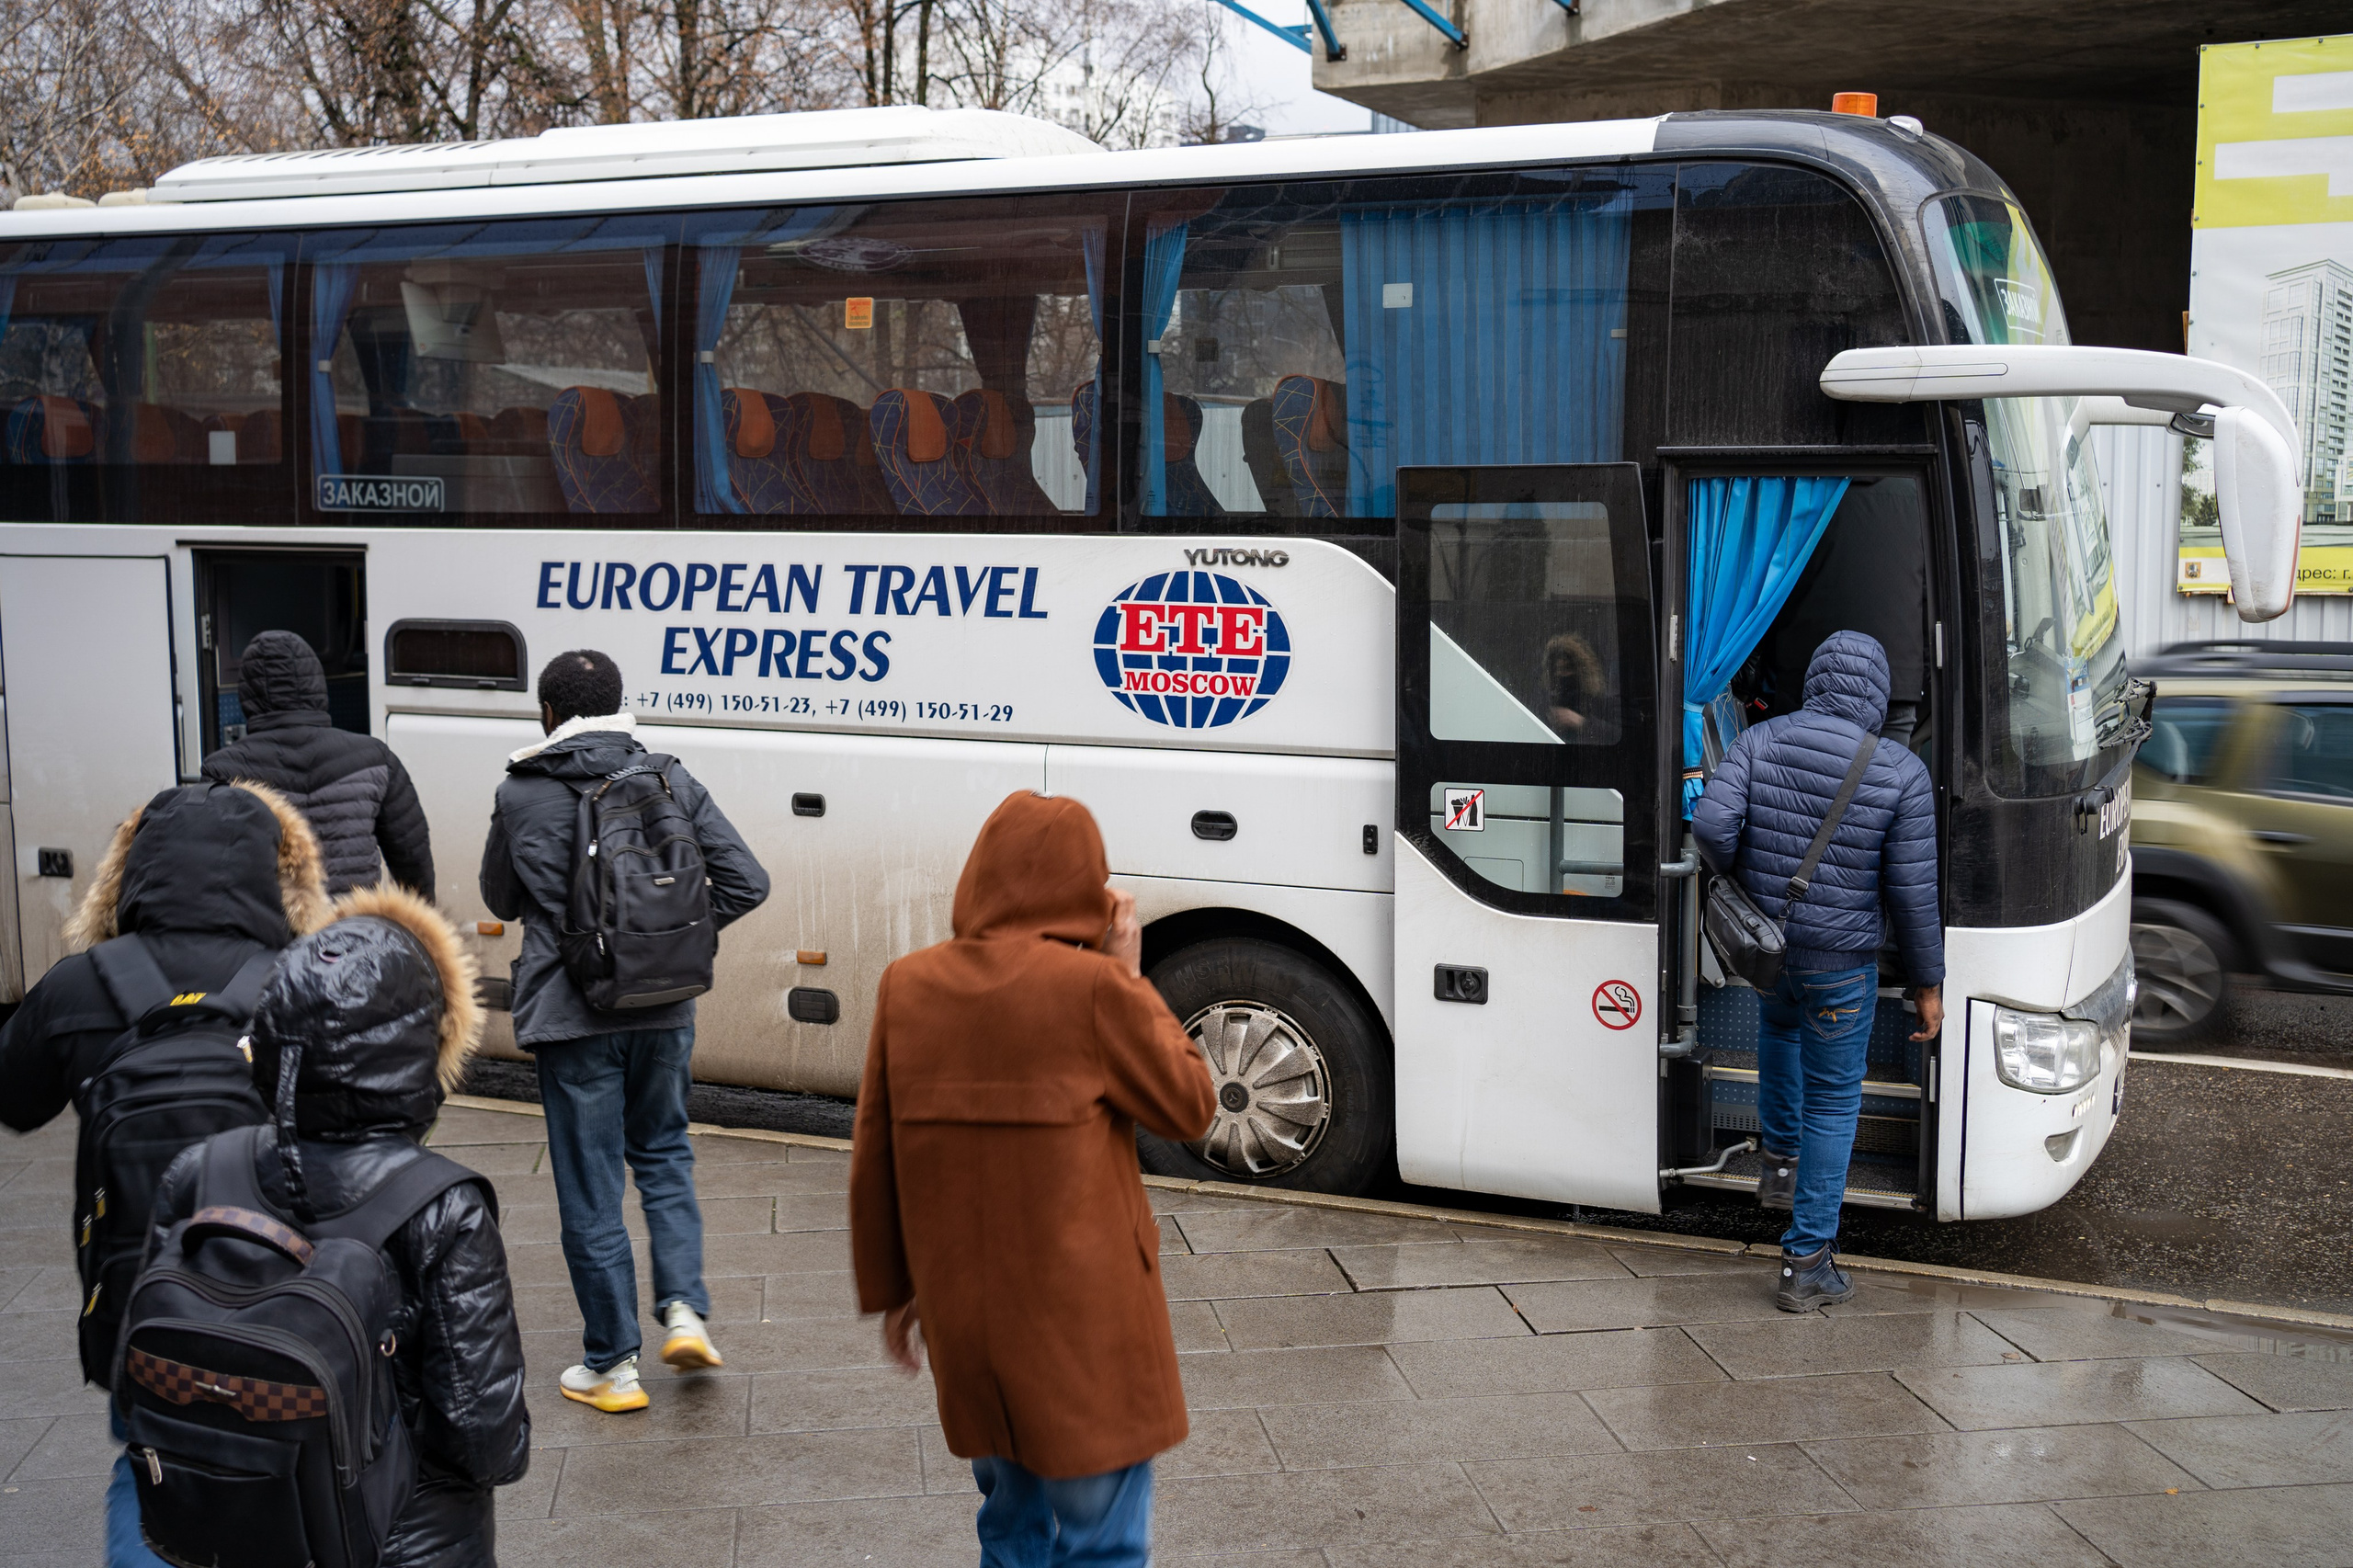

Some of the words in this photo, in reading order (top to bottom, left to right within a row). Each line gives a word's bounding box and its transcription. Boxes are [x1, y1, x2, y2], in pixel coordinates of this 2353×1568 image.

[323, 481, 439, 507] ЗАКАЗНОЙ
[1184, 549, 1290, 567] YUTONG
[2297, 569, 2336, 582] рес:
[537, 562, 823, 614] EUROPEAN
[844, 564, 1049, 619] TRAVEL
[1120, 603, 1263, 656] ETE
[661, 627, 892, 682] EXPRESS
[1124, 671, 1256, 697] MOSCOW
[637, 692, 659, 708] +7
[667, 692, 712, 714] (499)
[721, 695, 816, 718] 150-51-23,
[825, 699, 849, 715] +7
[858, 699, 906, 722] (499)
[916, 702, 1013, 722] 150-51-29
